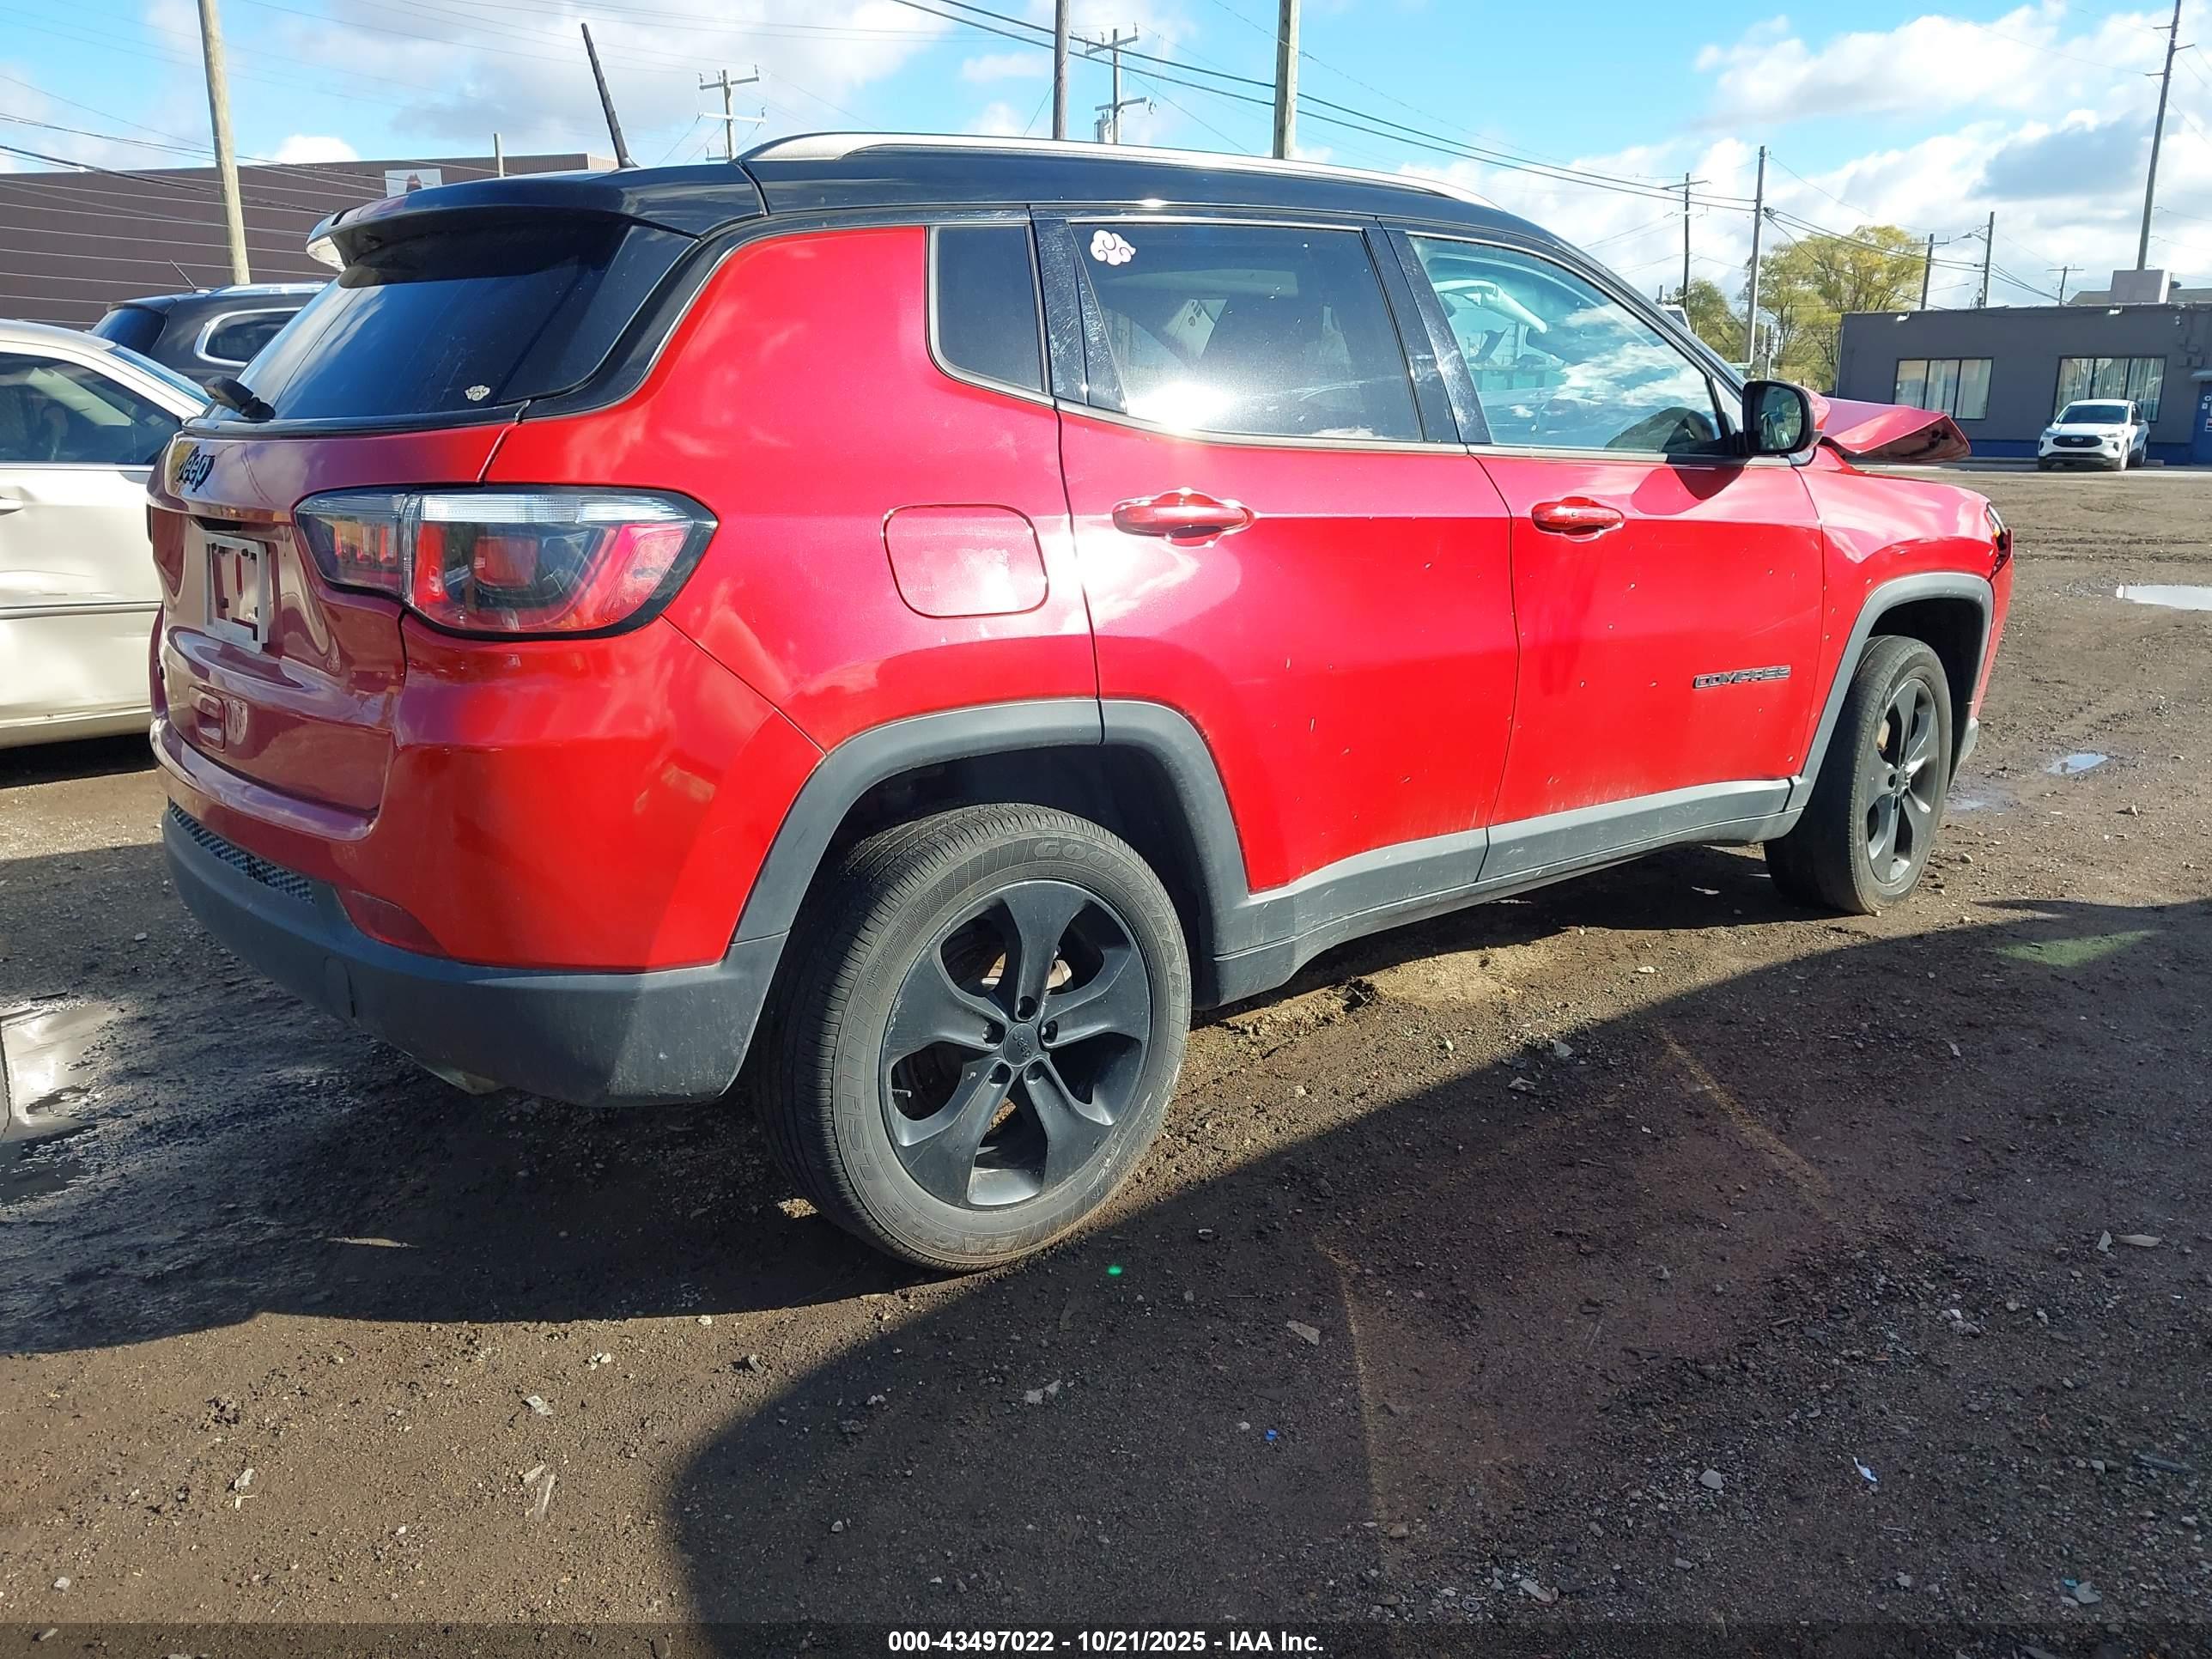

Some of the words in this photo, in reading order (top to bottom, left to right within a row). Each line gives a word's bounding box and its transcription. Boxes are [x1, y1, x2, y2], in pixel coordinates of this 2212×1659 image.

[176, 446, 216, 492] Jeep
[1692, 665, 1791, 689] COMPASS
[1035, 836, 1183, 997] GOODYEAR
